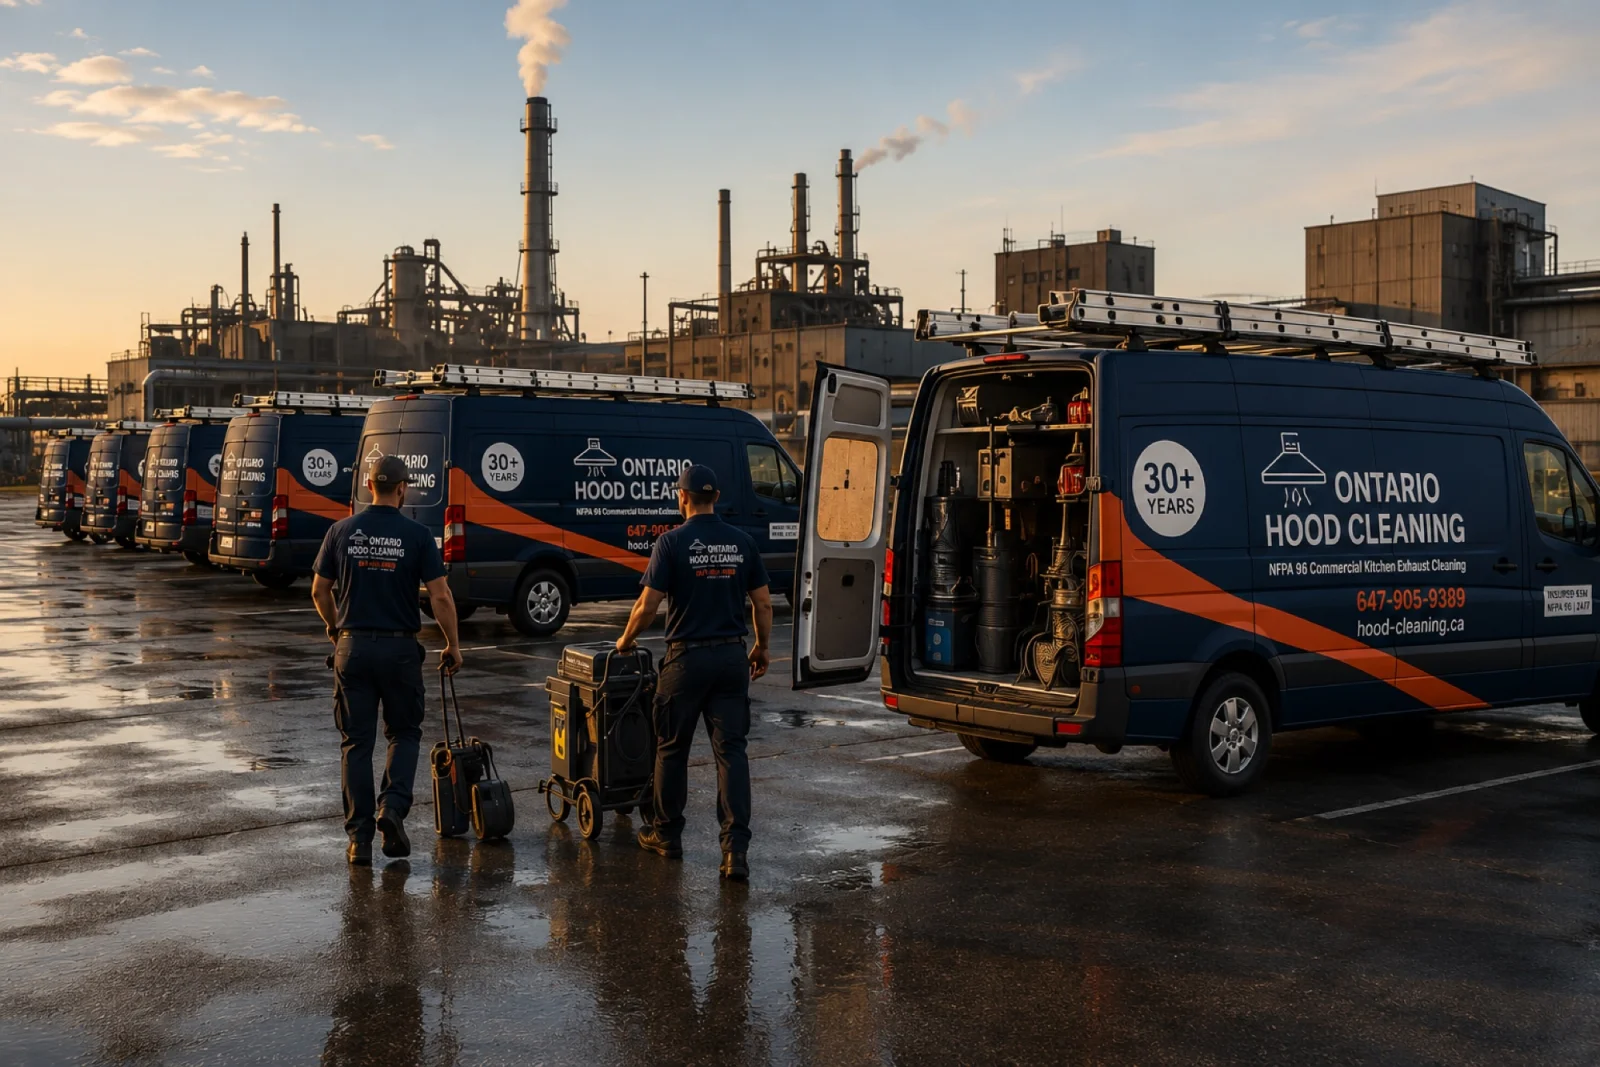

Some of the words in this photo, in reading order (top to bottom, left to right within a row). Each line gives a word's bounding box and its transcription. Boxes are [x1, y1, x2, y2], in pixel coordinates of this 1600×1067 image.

[307, 456, 333, 470] 30+
[488, 453, 519, 471] 30+
[309, 471, 332, 479] YEARS
[490, 472, 518, 482] YEARS
[1143, 462, 1194, 494] 30+
[575, 481, 625, 500] HOOD
[1334, 471, 1440, 503] ONTARIO
[1147, 497, 1195, 515] YEARS
[1265, 513, 1341, 547] HOOD
[1348, 513, 1466, 545] CLEANING
[369, 536, 402, 547] ONTARIO
[707, 544, 738, 553] ONTARIO
[1269, 562, 1294, 576] NFPA
[1296, 562, 1308, 575] 96
[1309, 560, 1362, 575] Commercial
[1364, 559, 1396, 573] Kitchen
[1397, 559, 1430, 572] Exhaust
[1431, 558, 1467, 573] Cleaning
[1356, 587, 1466, 612] 647-905-9389
[1357, 616, 1465, 637] hood-cleaning.ca
